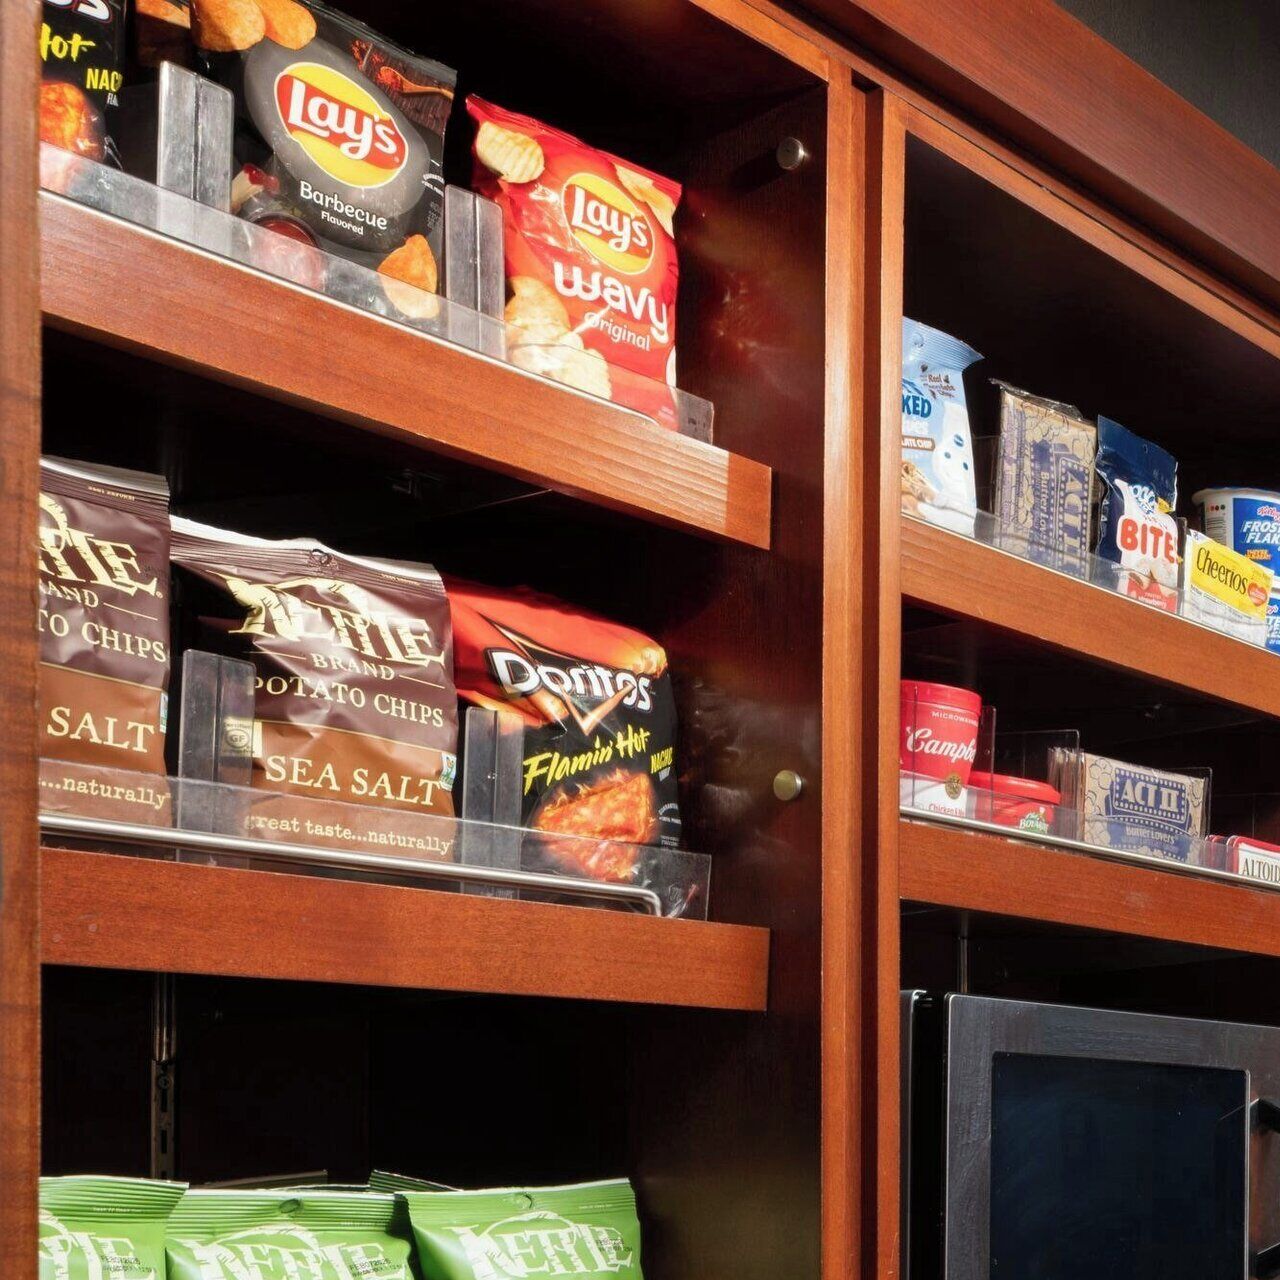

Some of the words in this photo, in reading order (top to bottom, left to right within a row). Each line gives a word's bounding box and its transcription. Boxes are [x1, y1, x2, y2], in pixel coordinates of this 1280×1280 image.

[287, 77, 397, 160] Lay's
[300, 180, 388, 230] Barbecue
[321, 209, 365, 235] Flavored
[569, 186, 650, 267] Lay's
[584, 310, 652, 352] Original
[1196, 546, 1249, 595] Cheerios
[81, 621, 167, 663] CHIPS
[312, 652, 395, 681] BRAND
[247, 673, 367, 709] POTATO
[373, 692, 444, 728] CHIPS
[490, 650, 652, 712] Doritos
[47, 705, 155, 753] SALT
[265, 754, 341, 792] SEA
[351, 767, 443, 806] SALT
[523, 736, 615, 796] Flamin'
[616, 724, 651, 758] Hot
[1121, 778, 1158, 808] ACT
[1159, 786, 1180, 813] II
[244, 813, 301, 834] great
